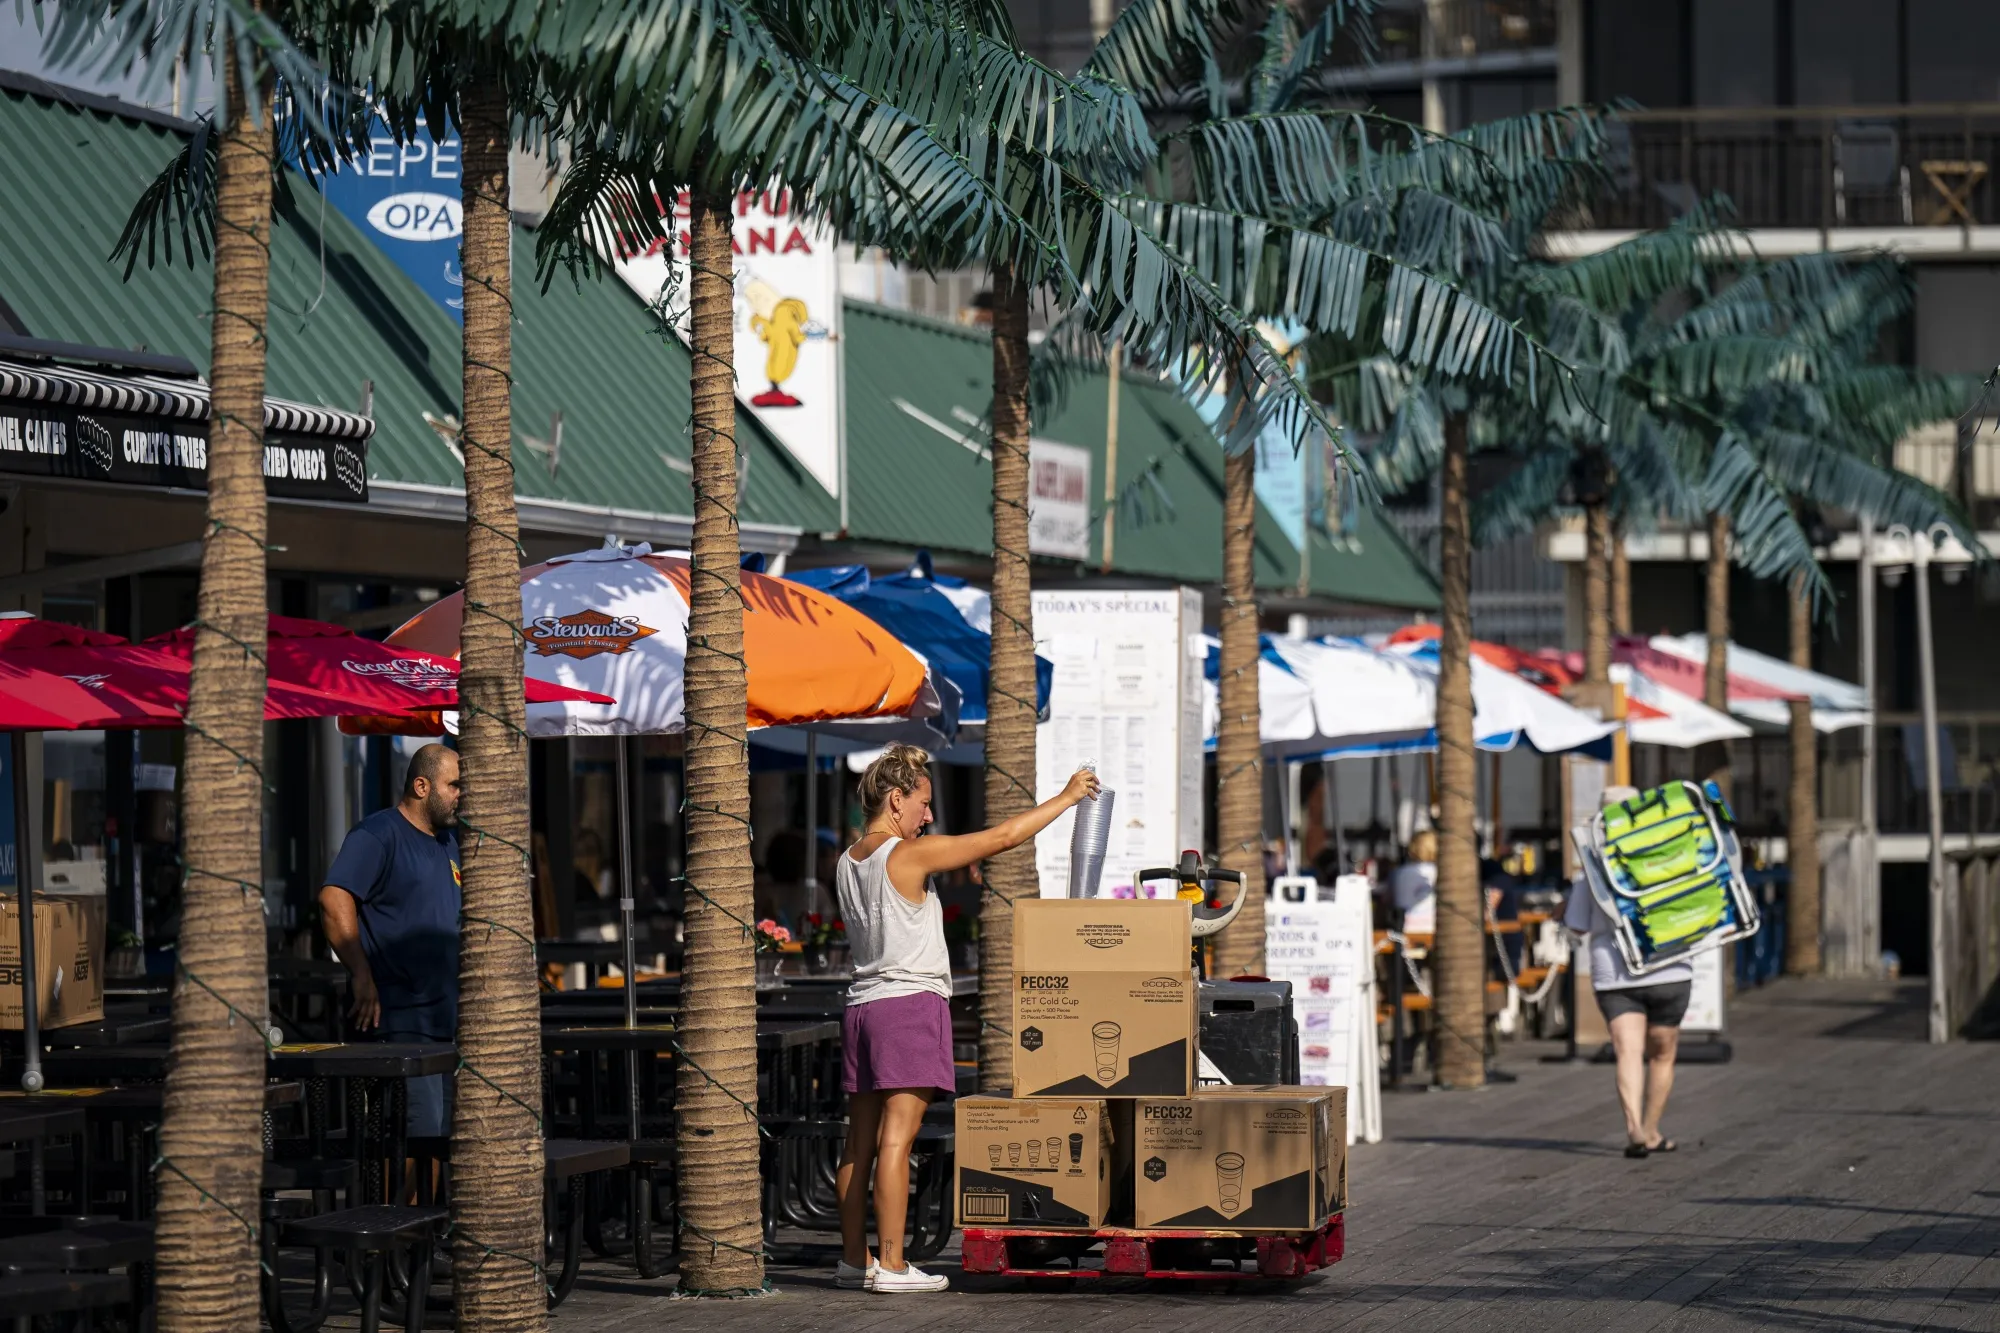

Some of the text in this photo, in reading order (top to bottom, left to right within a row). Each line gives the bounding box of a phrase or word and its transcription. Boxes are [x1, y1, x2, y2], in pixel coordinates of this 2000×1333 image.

[385, 203, 455, 232] OPA
[25, 418, 67, 456] CAKES
[123, 429, 207, 470] CURLY'S FRIES
[263, 445, 327, 481] RIED OREO'S
[1037, 600, 1172, 614] TODAY'S SPECIAL
[547, 640, 619, 649] Fountain Classics
[341, 658, 451, 676] Coca-Cola
[1084, 937, 1123, 946] ecopax
[1266, 931, 1305, 942] YROS
[1266, 946, 1315, 958] REPES
[1020, 976, 1069, 989] PECC32
[1142, 979, 1183, 988] ecopax
[1021, 997, 1079, 1006] PET Cold Cup
[1144, 1106, 1192, 1119] PECC32
[1266, 1110, 1307, 1119] ecopax
[1144, 1128, 1203, 1137] PET Cold Cup
